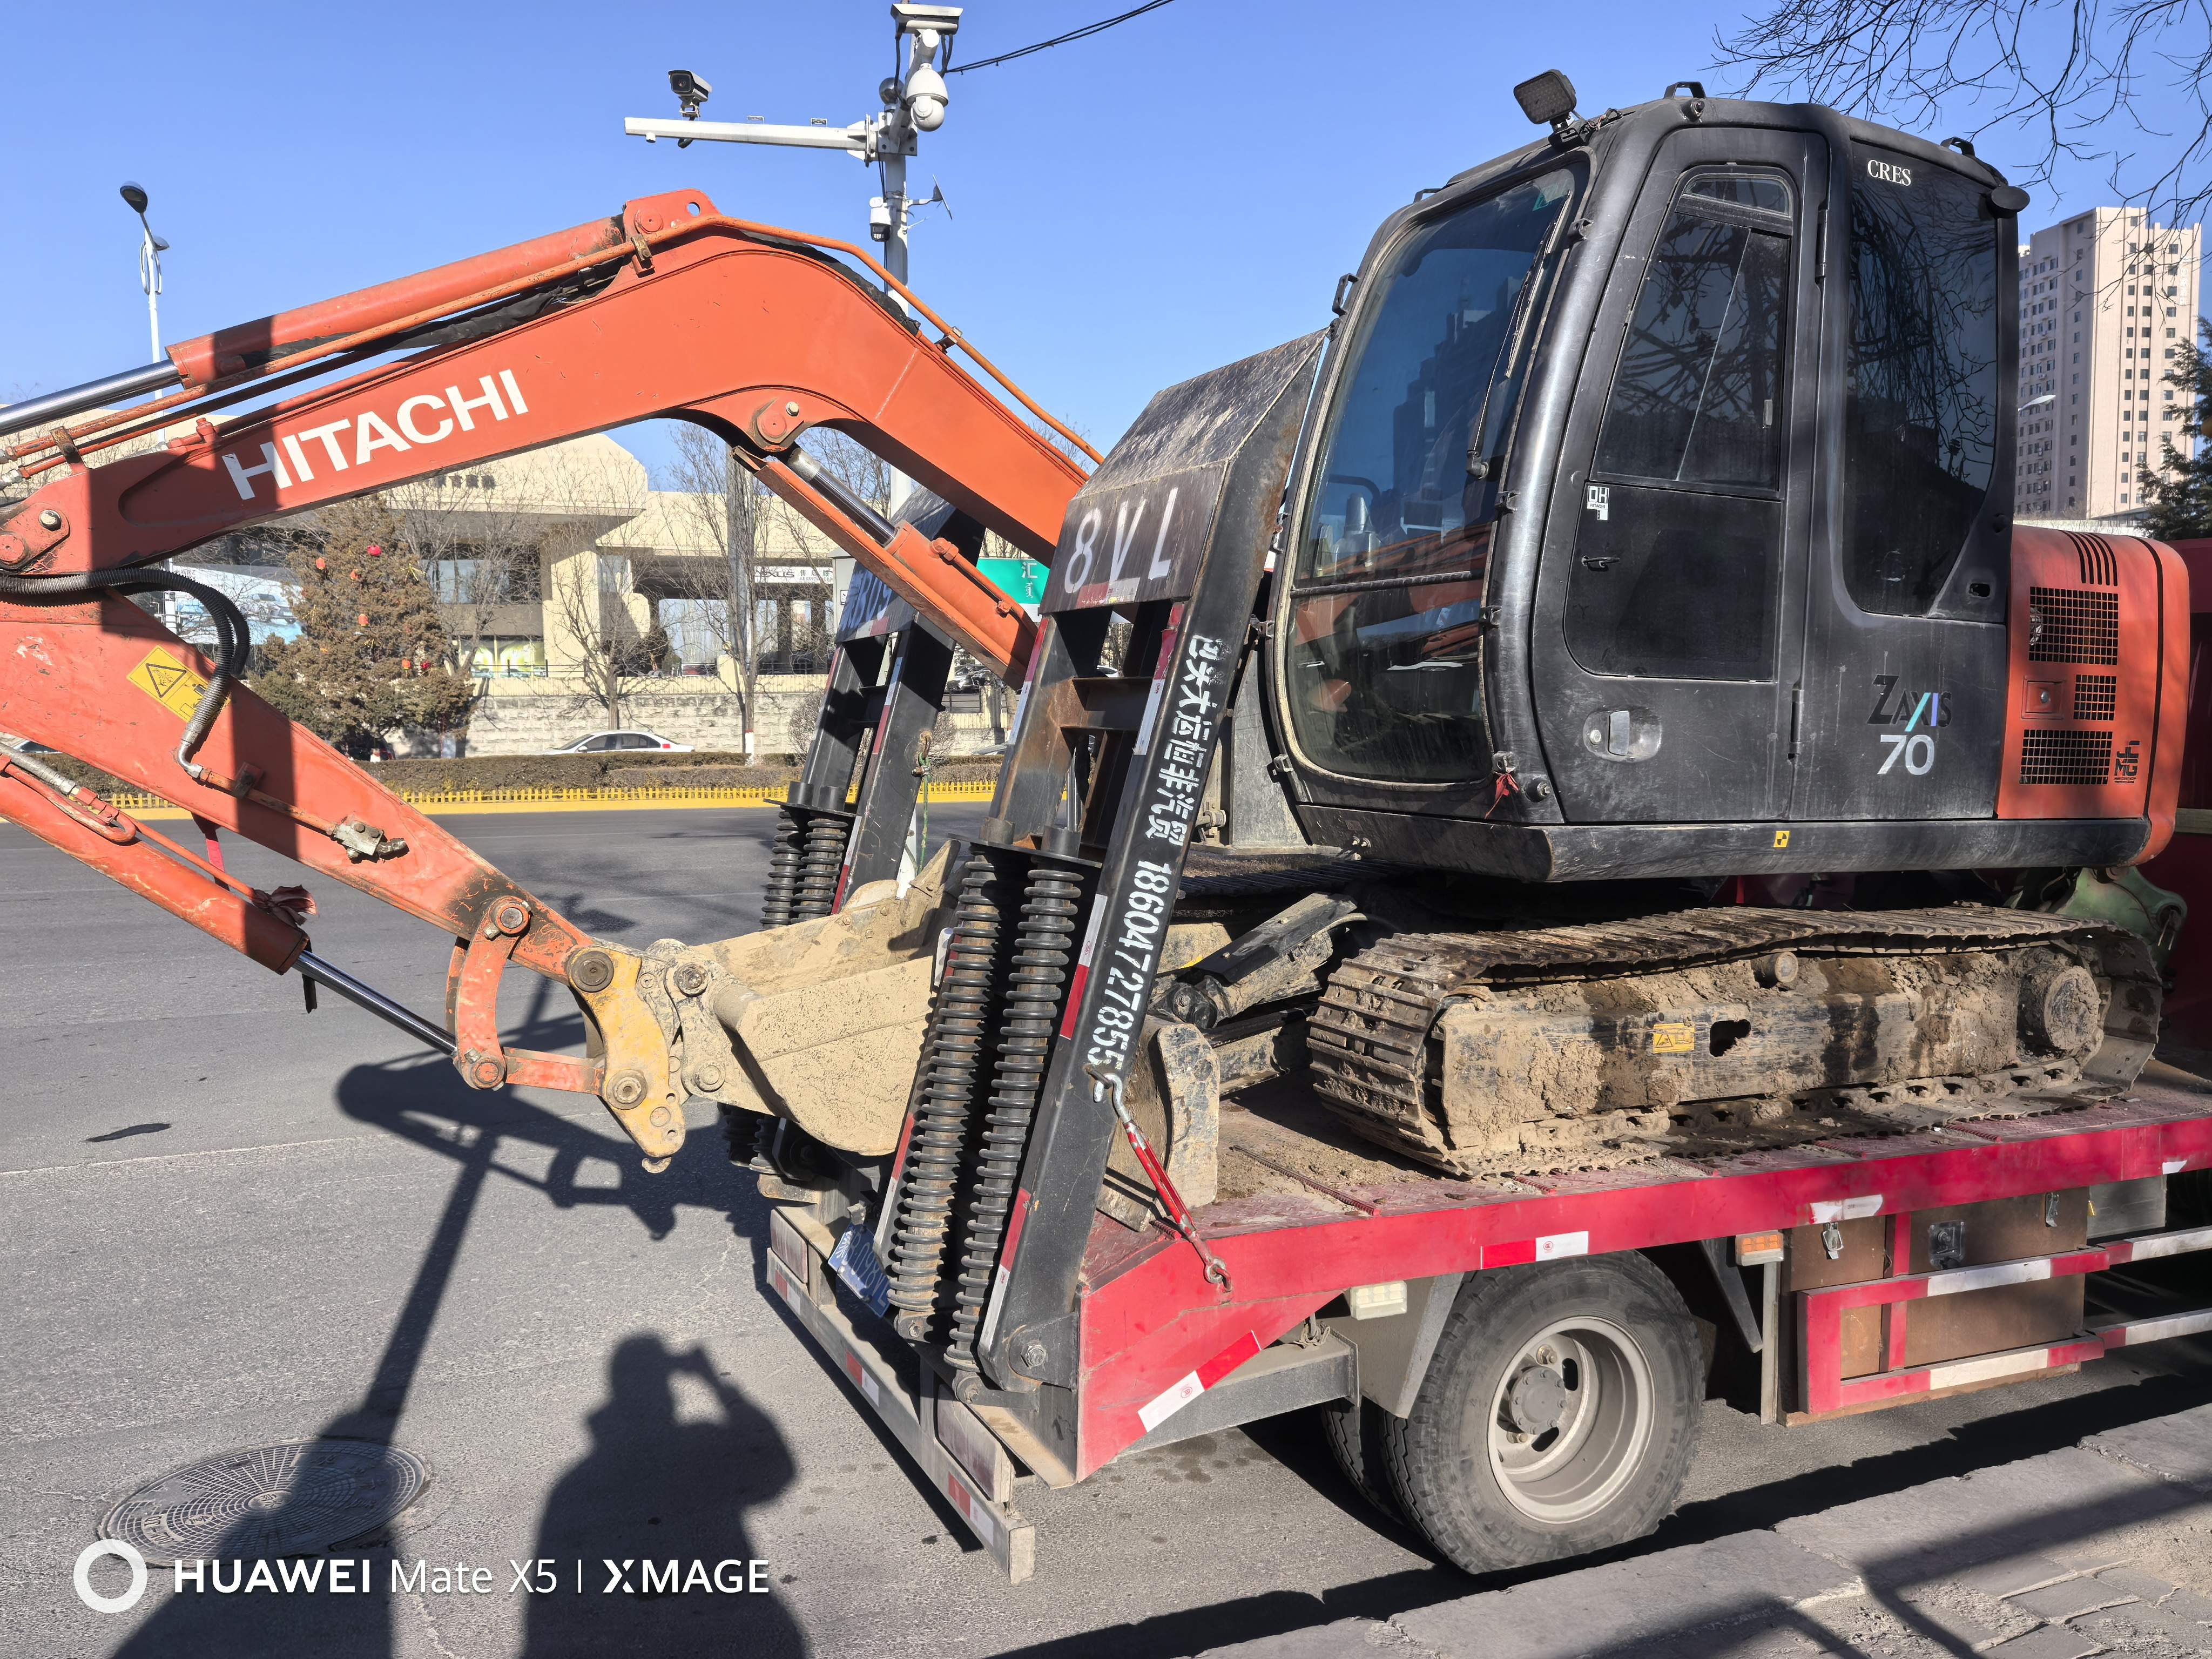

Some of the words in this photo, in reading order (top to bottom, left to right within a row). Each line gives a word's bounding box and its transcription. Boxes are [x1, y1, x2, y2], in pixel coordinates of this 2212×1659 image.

[1867, 159, 1912, 187] CRES
[221, 368, 529, 500] HITACHI
[1064, 487, 1178, 594] 8VL
[1021, 561, 1038, 579] 汇
[1866, 674, 1952, 732] ZAXIS
[1877, 734, 1935, 775] 70
[1087, 860, 1172, 1070] 18604727855
